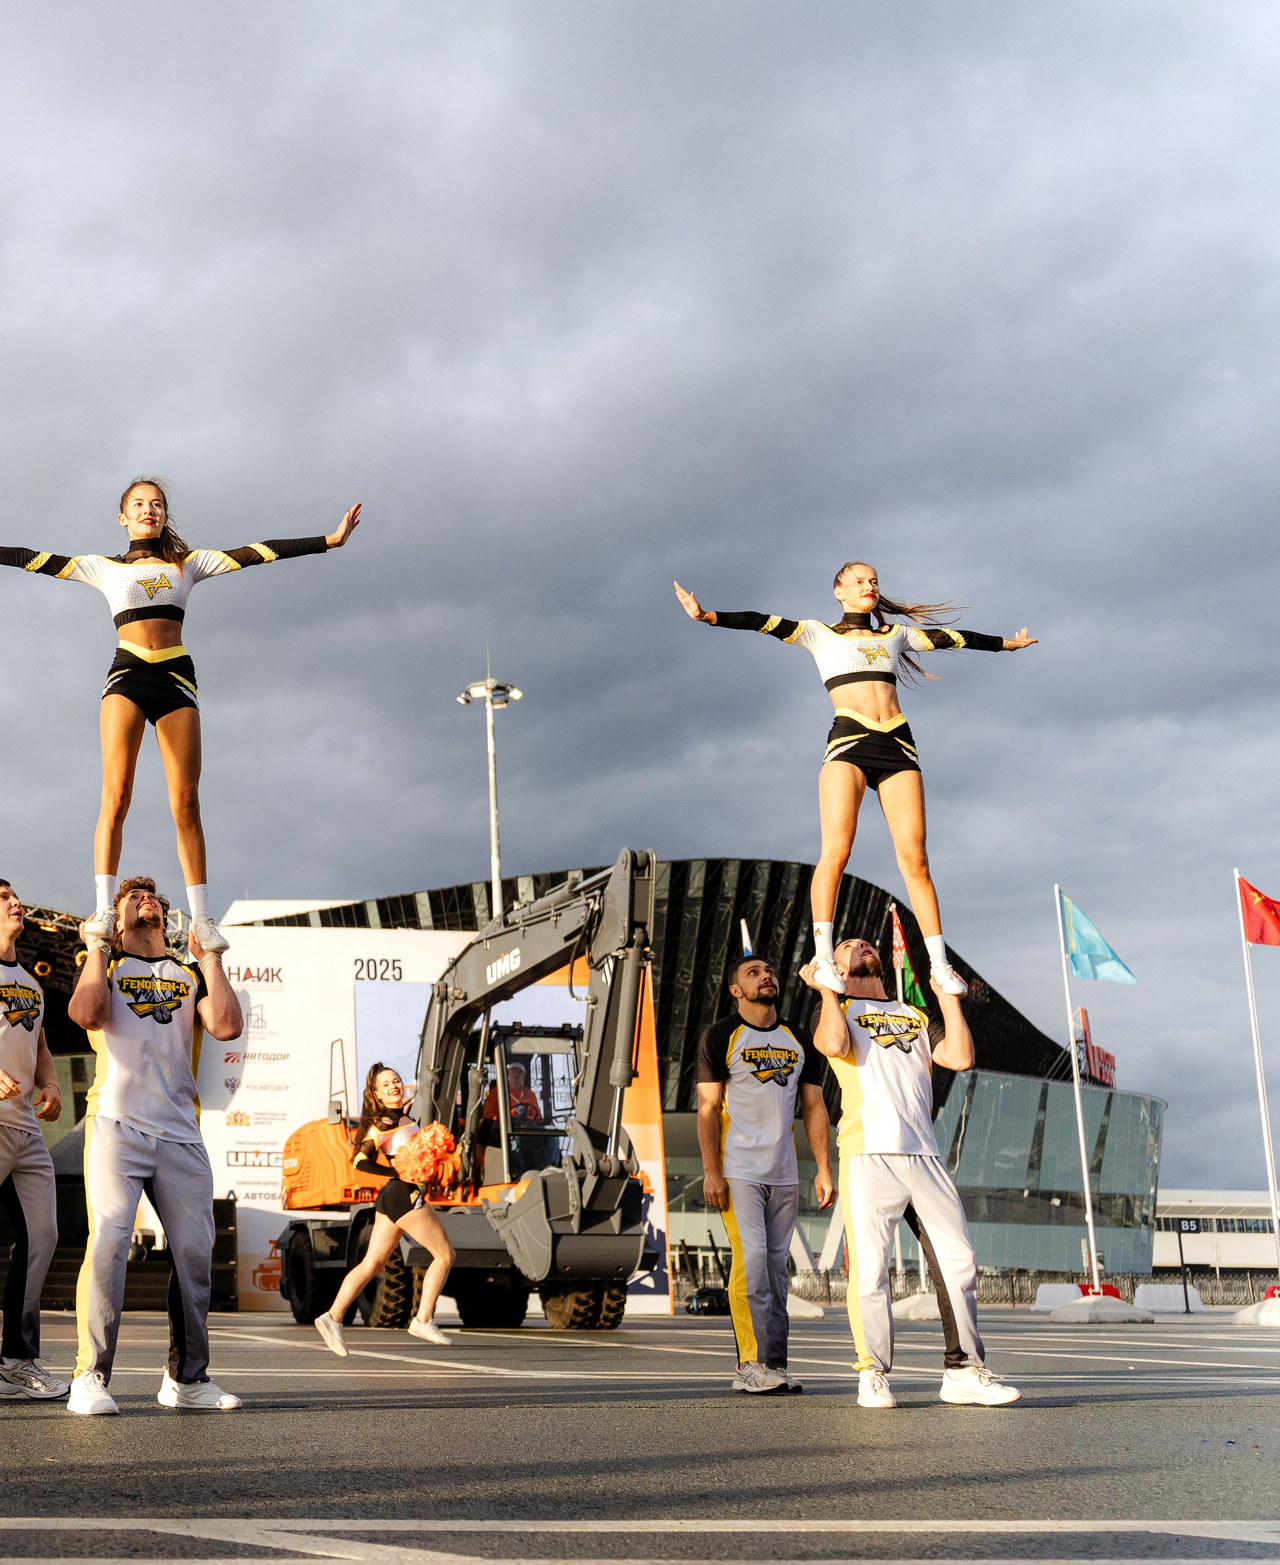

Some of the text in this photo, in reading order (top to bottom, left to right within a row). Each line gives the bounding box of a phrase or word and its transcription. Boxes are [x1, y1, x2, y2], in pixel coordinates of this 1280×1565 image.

[227, 966, 283, 983] НАИК
[354, 958, 403, 981] 2025
[486, 947, 521, 986] UMG
[122, 979, 188, 995] FENOMEN-A
[859, 1014, 921, 1028] FENOMEN-A
[243, 1052, 290, 1061] АВТОДОР
[744, 1050, 797, 1061] FENOMEN-A
[226, 1151, 284, 1168] UMG
